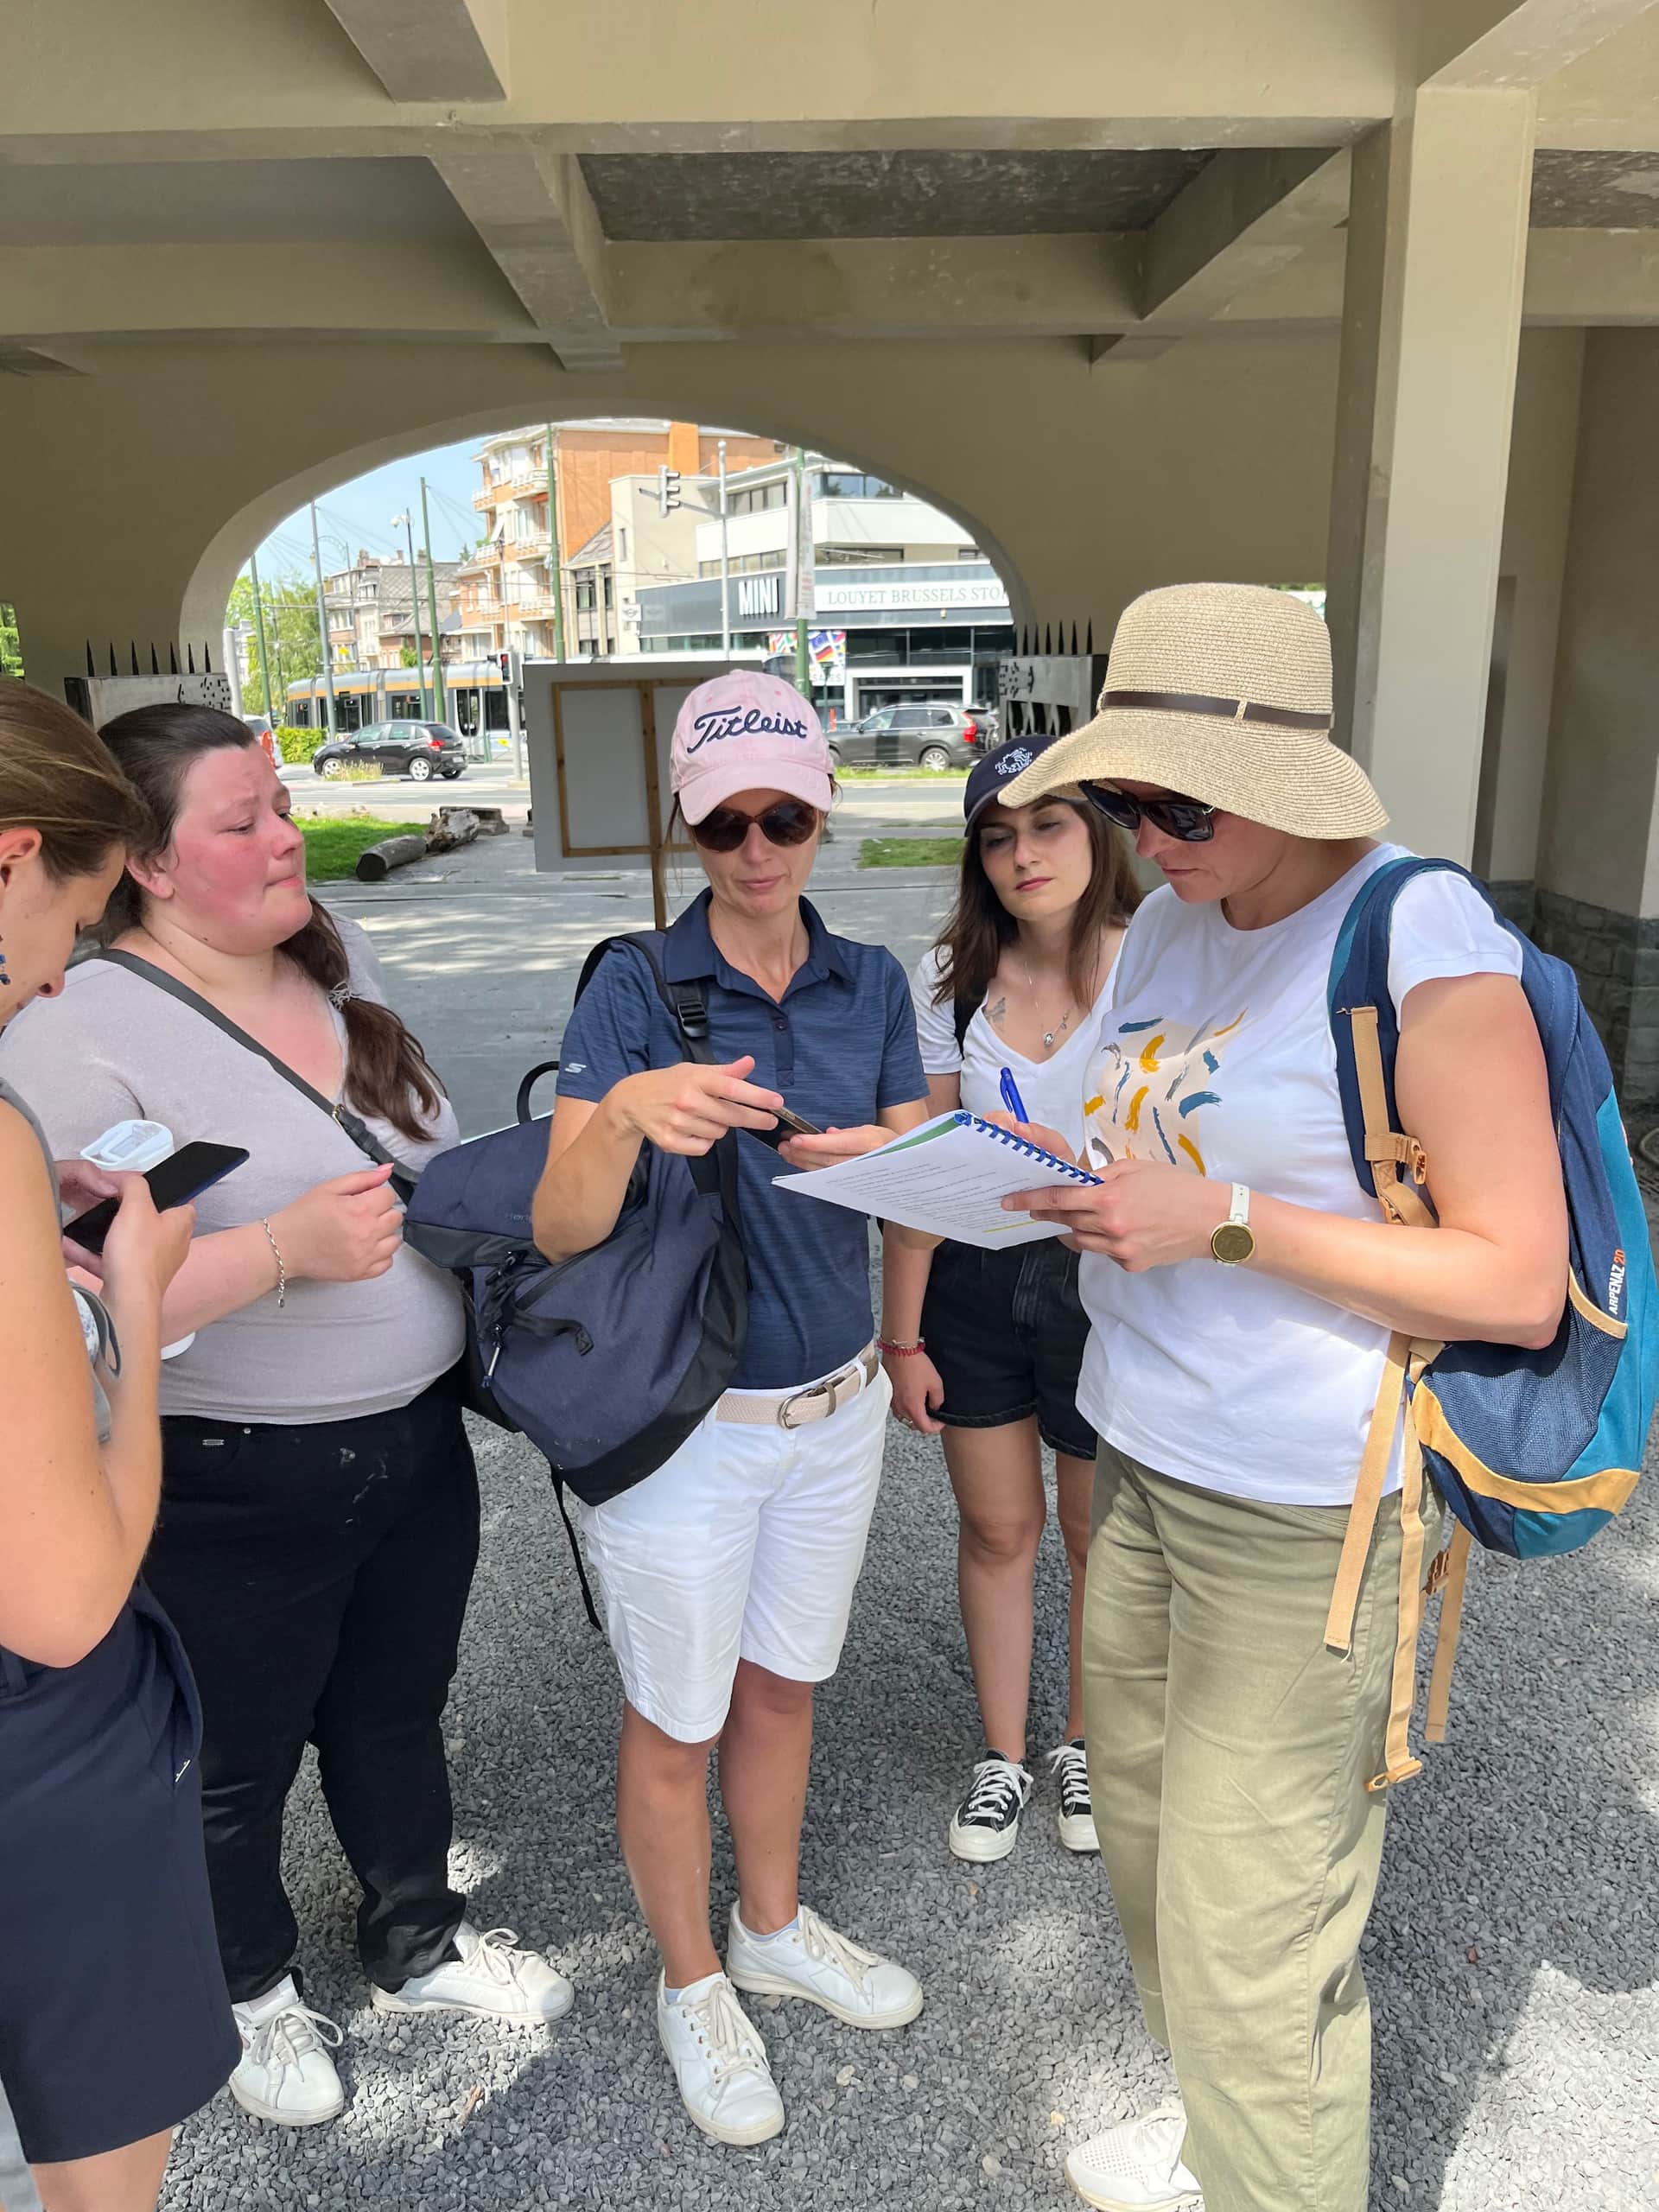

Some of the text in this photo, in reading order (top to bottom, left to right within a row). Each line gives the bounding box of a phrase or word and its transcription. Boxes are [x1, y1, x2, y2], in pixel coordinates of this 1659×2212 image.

[738, 577, 779, 616] MINI
[828, 589, 887, 606] LOUYET
[892, 587, 967, 603] BRUSSELS
[687, 705, 808, 753] Titleist
[1608, 1249, 1625, 1315] ARPENAZ 20
